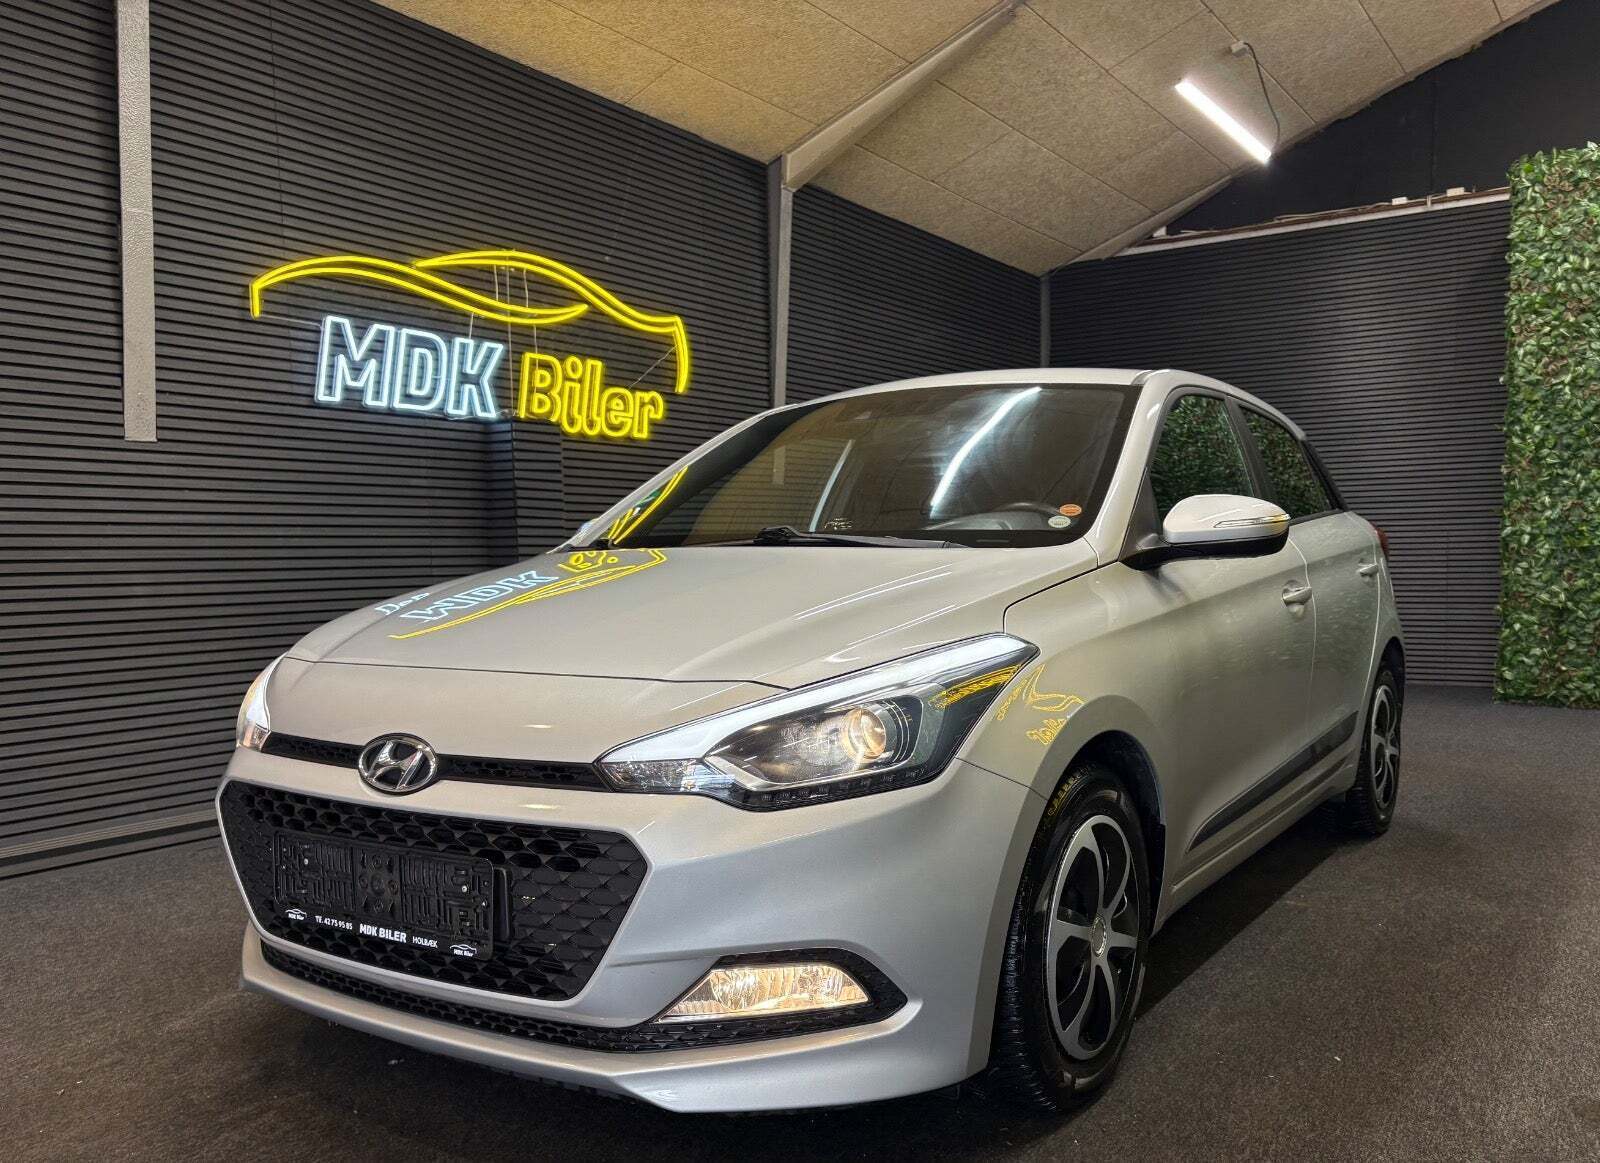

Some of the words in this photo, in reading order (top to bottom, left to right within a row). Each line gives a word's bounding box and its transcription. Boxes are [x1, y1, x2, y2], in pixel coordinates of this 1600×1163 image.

[315, 314, 504, 420] MDK
[517, 350, 666, 440] Biler
[359, 923, 378, 937] MDK
[378, 926, 407, 943] BILER
